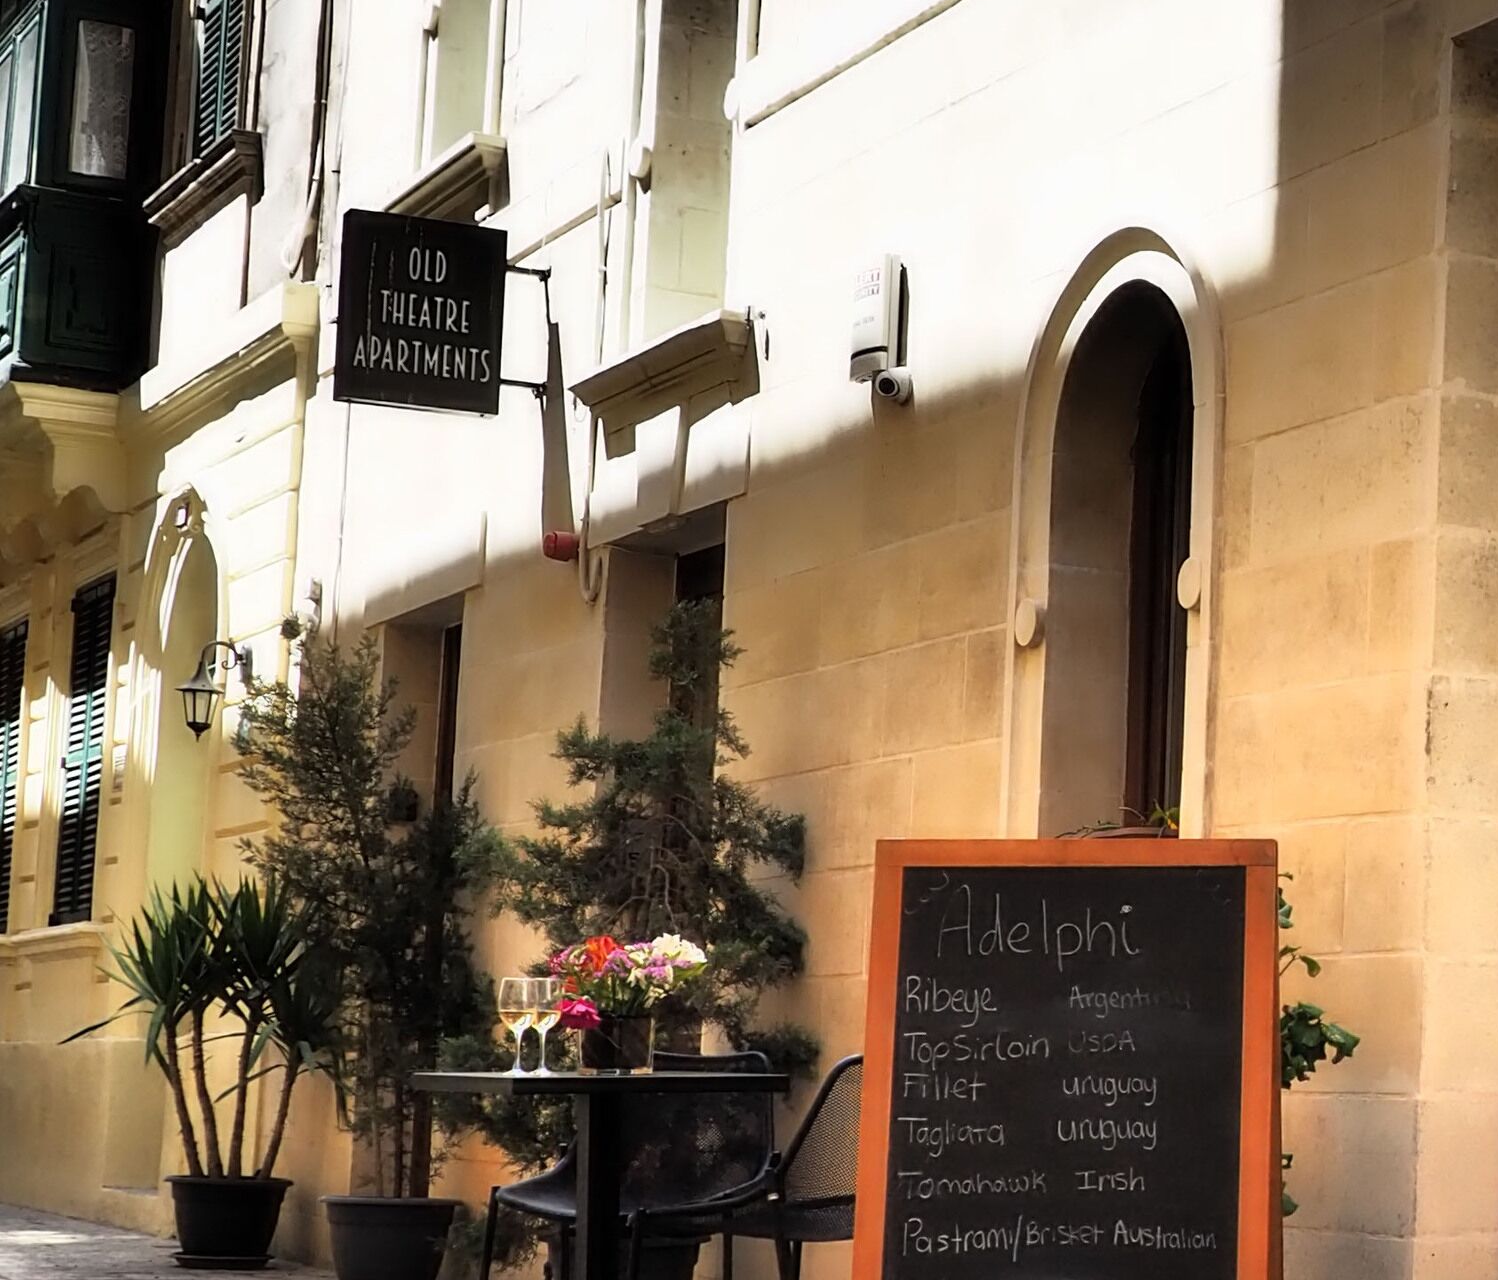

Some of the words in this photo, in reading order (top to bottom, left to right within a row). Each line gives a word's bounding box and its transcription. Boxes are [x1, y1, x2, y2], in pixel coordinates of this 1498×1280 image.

[409, 247, 447, 283] OLD
[380, 289, 471, 333] THEATRE
[353, 335, 490, 383] APARTMENTS
[937, 884, 1142, 972] Adelphi
[905, 975, 997, 1028] Ribeye
[1069, 985, 1191, 1018] Argenti
[903, 1071, 987, 1101] Fillet
[897, 1171, 1047, 1200] Tomahawk
[1075, 1168, 1145, 1192] Irish
[1113, 1219, 1217, 1250] Australian
